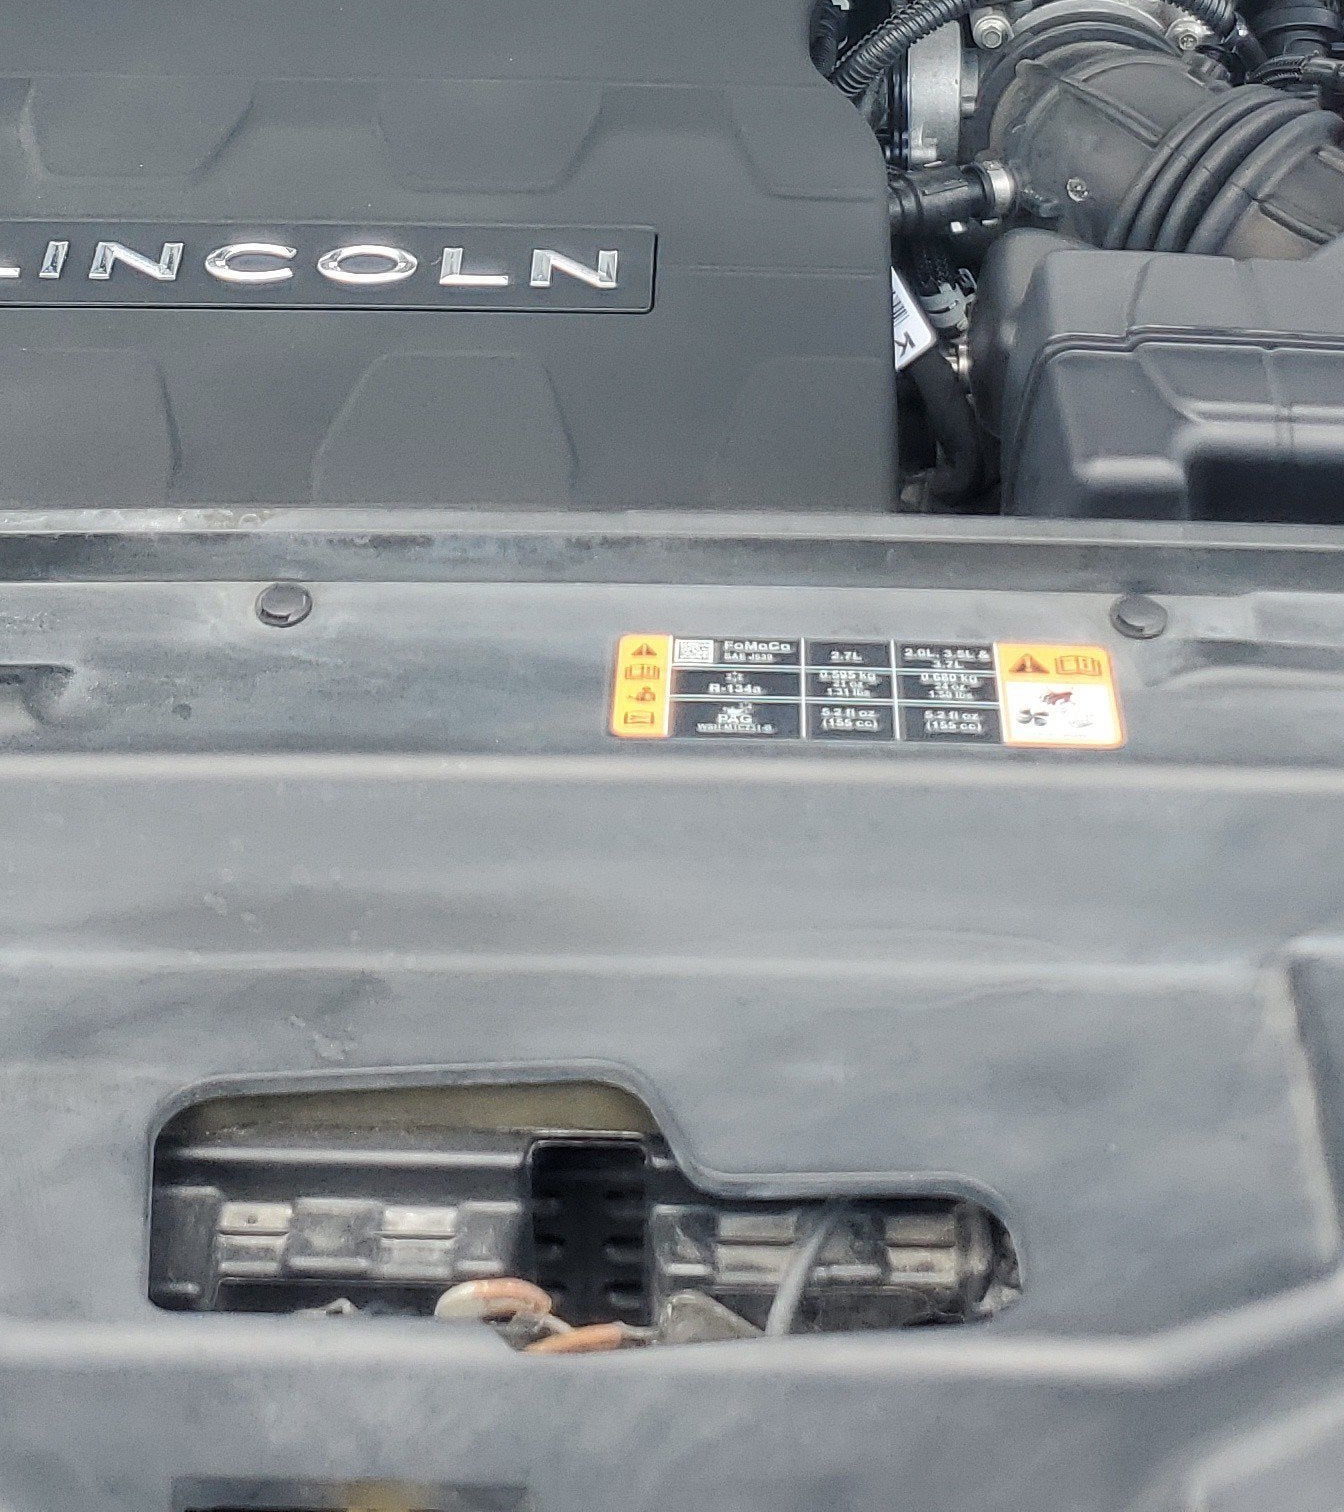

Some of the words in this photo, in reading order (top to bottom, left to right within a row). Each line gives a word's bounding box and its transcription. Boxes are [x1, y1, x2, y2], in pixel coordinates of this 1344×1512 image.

[724, 640, 791, 652] FoMoCo
[859, 670, 877, 683] kg
[960, 673, 978, 686] kg
[708, 683, 762, 694] R-134a
[717, 713, 753, 724] PAG
[858, 709, 876, 717] oz
[961, 712, 979, 720] oz
[855, 719, 878, 729] cc)
[959, 723, 982, 732] cc)
